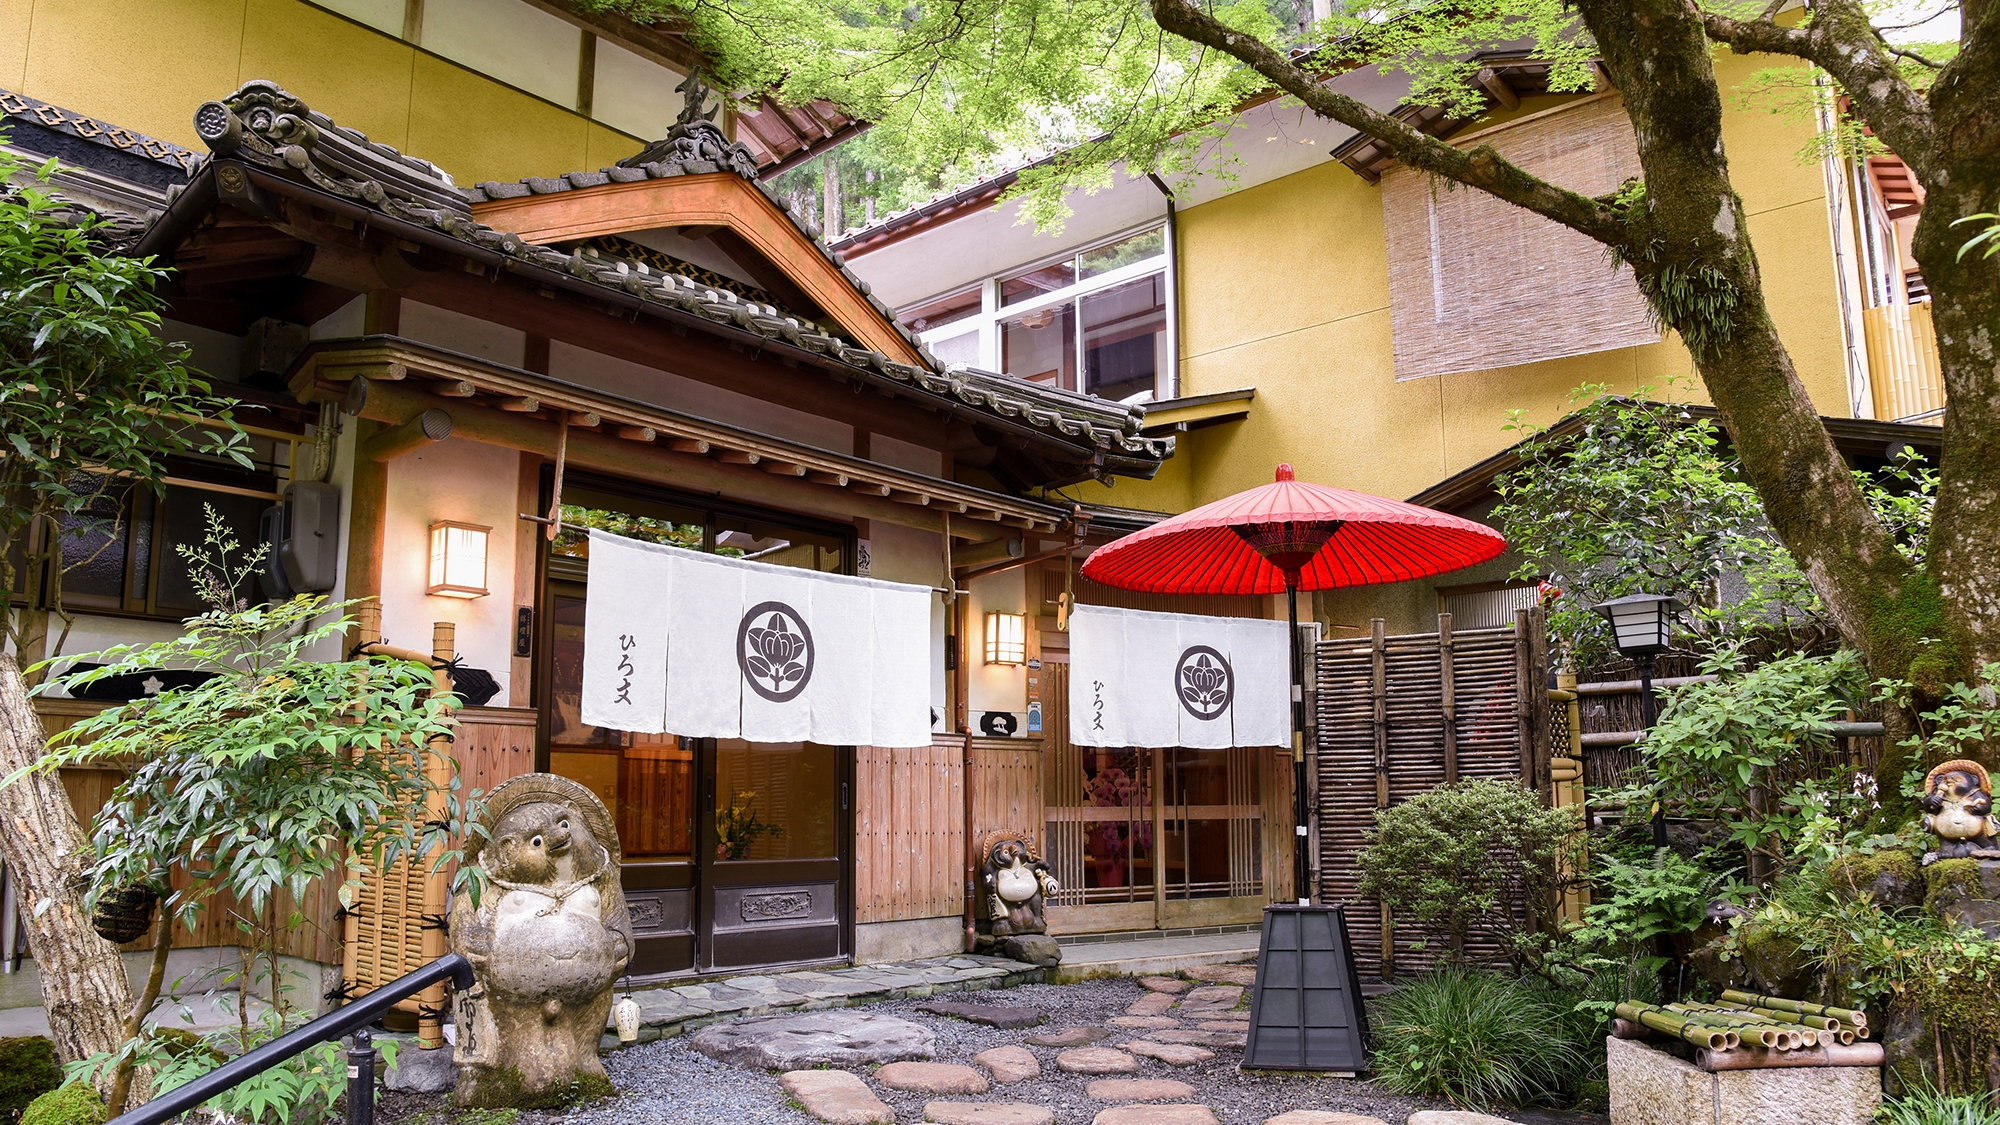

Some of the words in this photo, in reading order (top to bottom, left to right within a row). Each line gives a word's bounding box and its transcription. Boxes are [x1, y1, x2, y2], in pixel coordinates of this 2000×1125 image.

[613, 634, 636, 706] ひろ文
[1093, 680, 1105, 731] ひろ文
